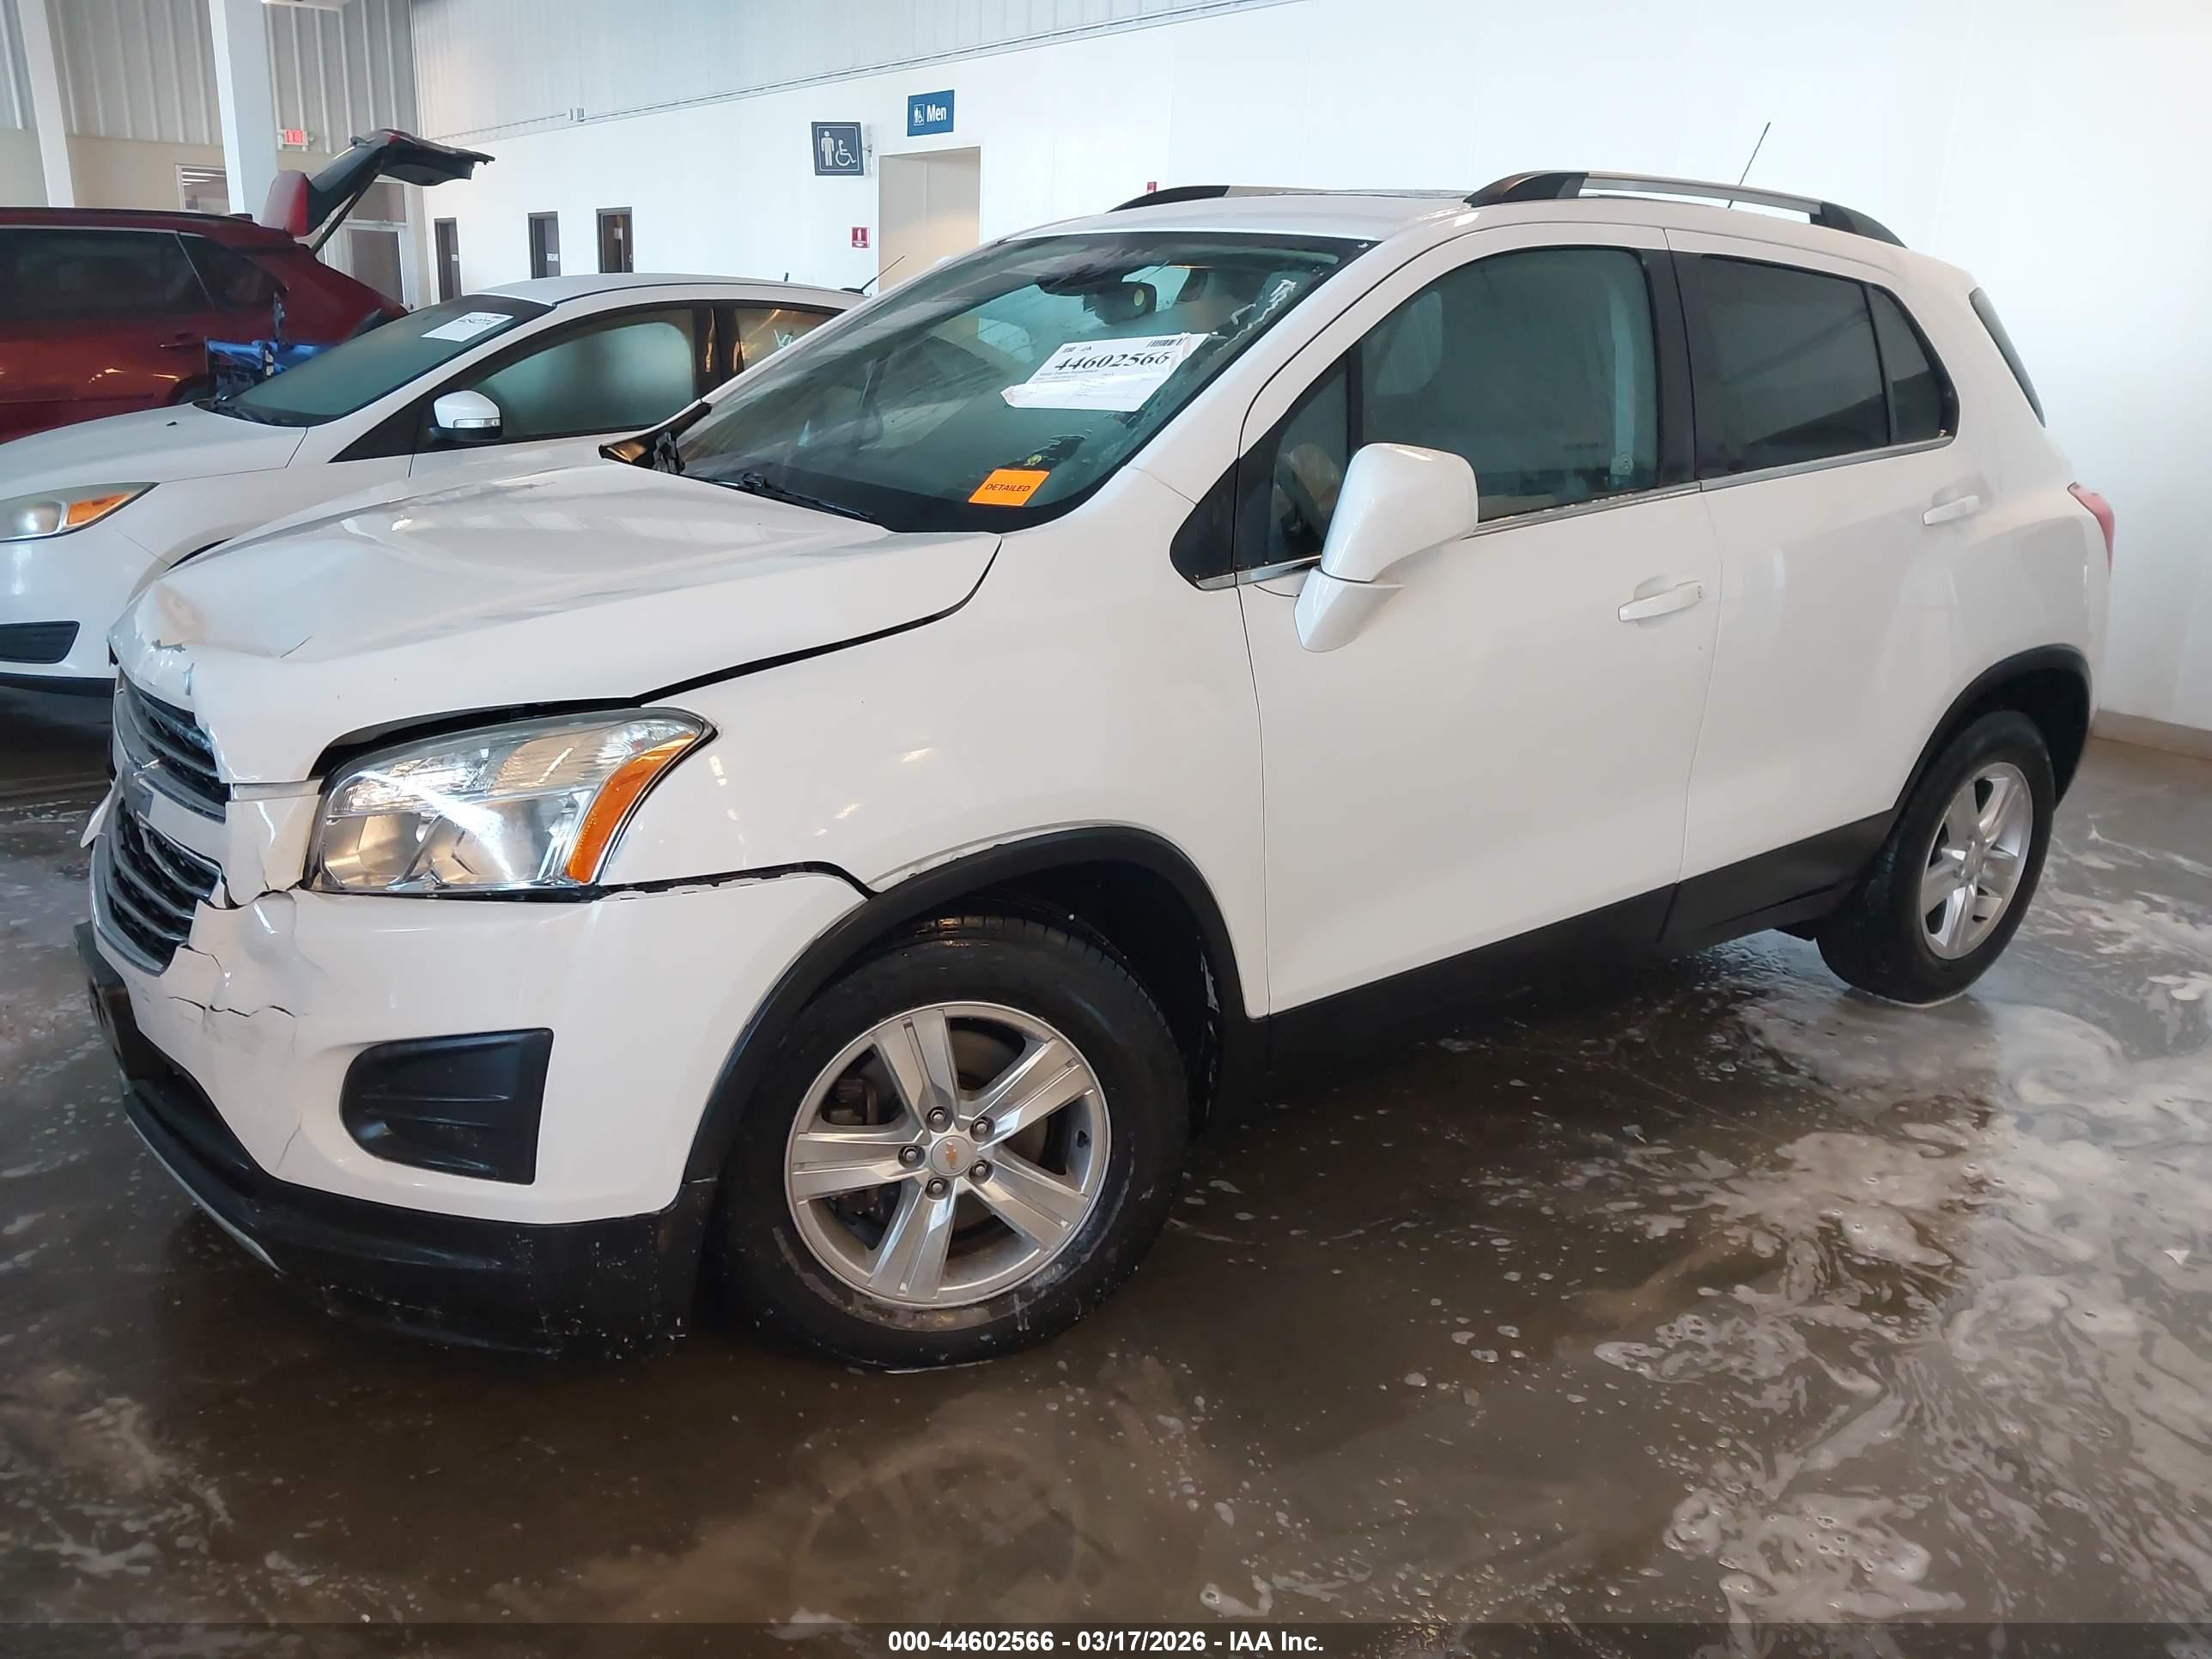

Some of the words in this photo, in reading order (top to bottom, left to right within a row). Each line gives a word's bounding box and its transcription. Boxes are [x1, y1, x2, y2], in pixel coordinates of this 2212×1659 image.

[927, 104, 947, 122] Men
[1055, 351, 1174, 370] 44602566
[985, 483, 1030, 492] DETAILED
